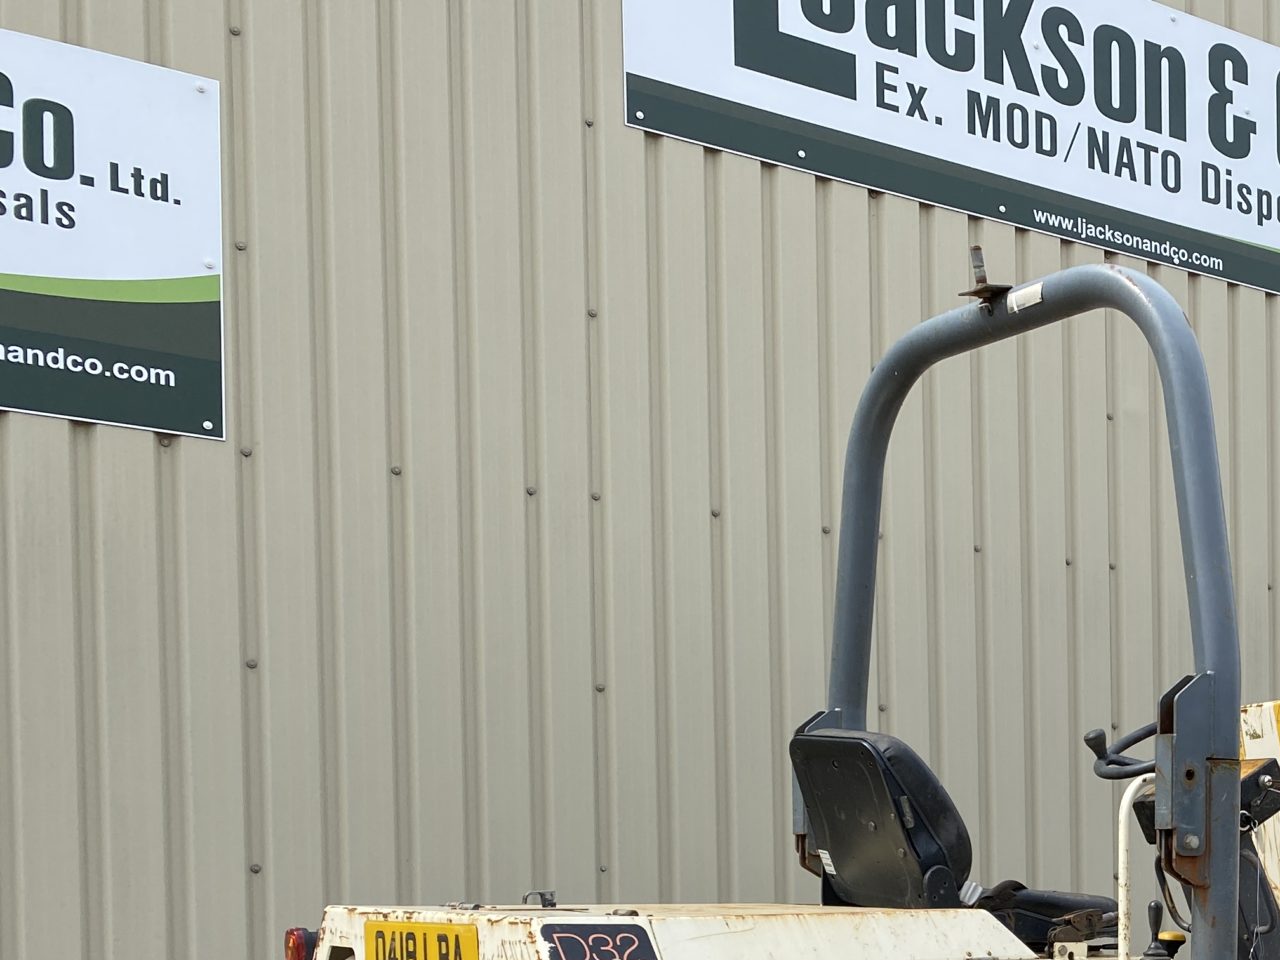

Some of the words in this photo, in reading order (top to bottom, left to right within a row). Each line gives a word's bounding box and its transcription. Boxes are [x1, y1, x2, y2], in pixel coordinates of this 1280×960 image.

[0, 70, 95, 187] o.
[109, 161, 181, 206] Ltd.
[875, 61, 943, 126] Ex.
[967, 89, 1181, 194] MOD/NATO
[1208, 43, 1257, 159] &
[1033, 208, 1223, 271] www.ljacksonandco.com
